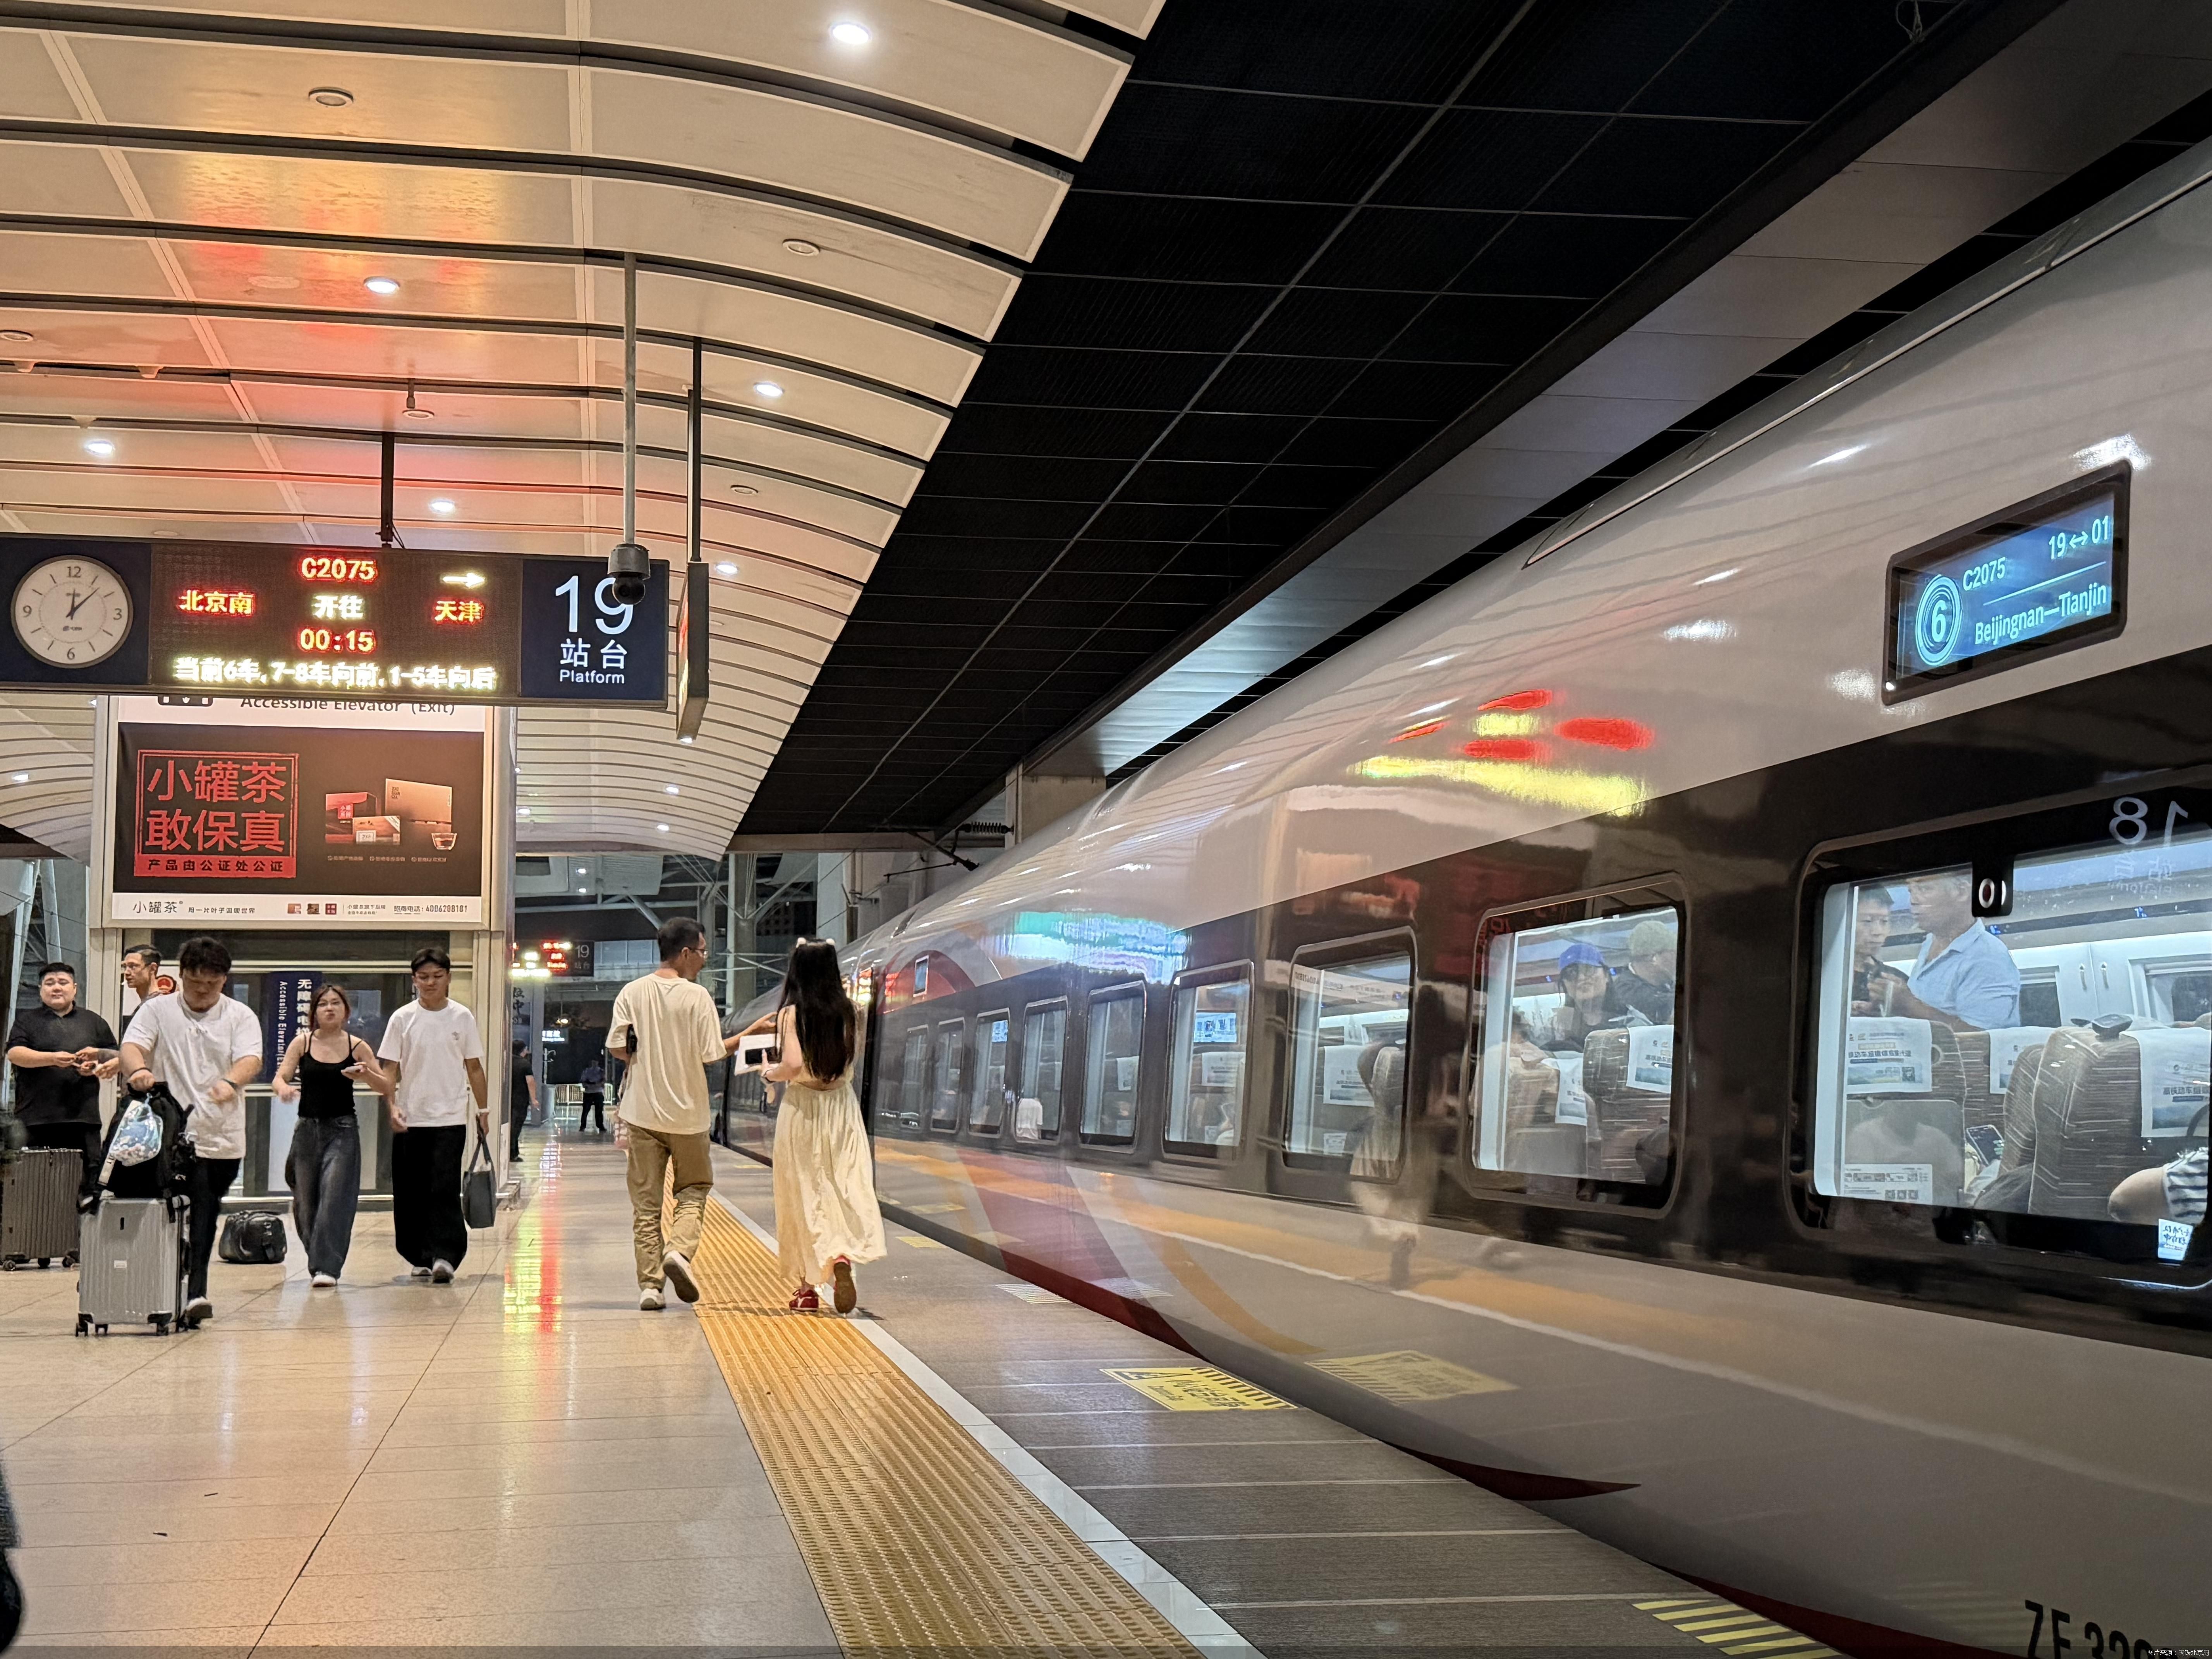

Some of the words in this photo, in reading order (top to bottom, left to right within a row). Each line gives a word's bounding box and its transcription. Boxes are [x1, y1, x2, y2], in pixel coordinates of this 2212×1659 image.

[1962, 557, 2006, 591] C2075
[2048, 532, 2067, 559] 19
[2092, 515, 2109, 544] 01
[67, 566, 82, 578] 12
[301, 557, 376, 580] C2075
[22, 606, 32, 617] 9
[180, 589, 254, 615] 北京南
[313, 595, 363, 620] 开往
[434, 600, 484, 623] 天津
[555, 575, 634, 635] 19
[113, 608, 122, 620] 3
[1930, 600, 1946, 643] 6
[300, 628, 374, 652] 00:15
[67, 647, 75, 660] 6
[560, 637, 627, 670] 站台
[560, 669, 625, 684] Platform
[240, 698, 327, 709] Accessible
[334, 701, 401, 712] Elevator
[147, 760, 287, 803] 小罐茶
[145, 809, 285, 852] 敢保真
[148, 859, 283, 872] 产品由公证处公证
[133, 901, 177, 914] 小罐茶
[576, 945, 589, 958] 19
[278, 981, 288, 1020] Accessible
